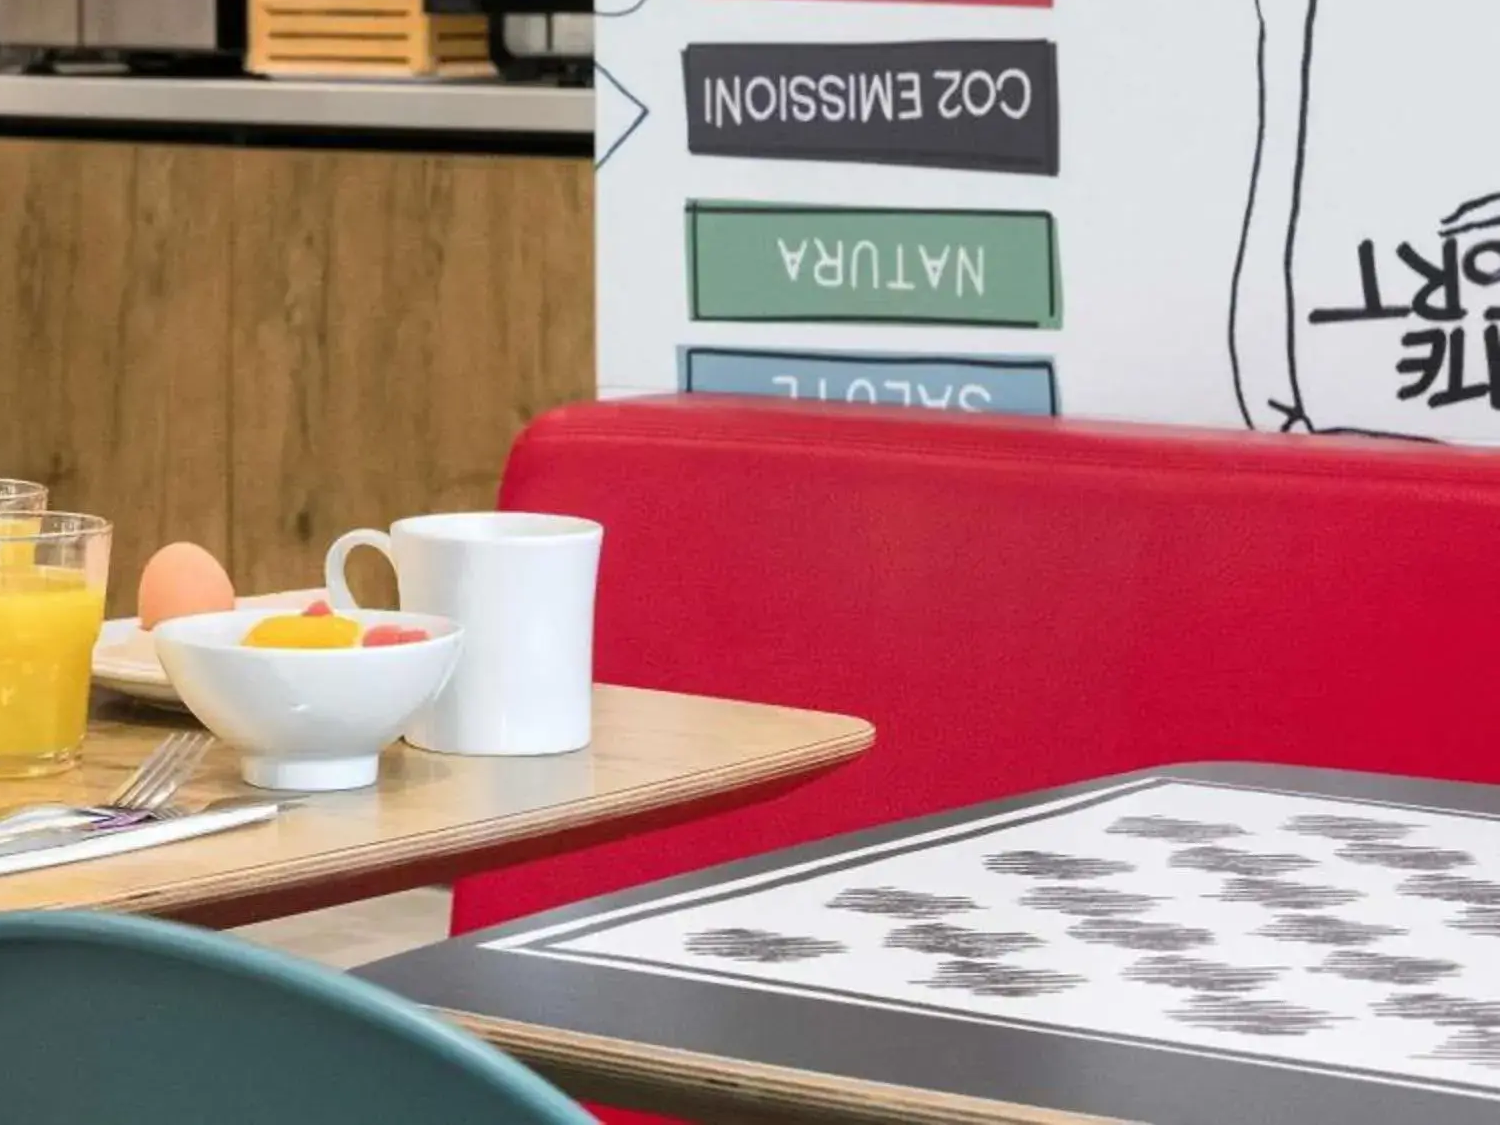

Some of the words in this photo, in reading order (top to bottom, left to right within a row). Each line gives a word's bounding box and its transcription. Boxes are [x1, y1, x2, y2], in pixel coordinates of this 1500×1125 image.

[703, 70, 922, 129] EMISSIONI
[932, 68, 1032, 120] CO2
[776, 236, 985, 297] NATURA
[1307, 237, 1500, 325] ORT
